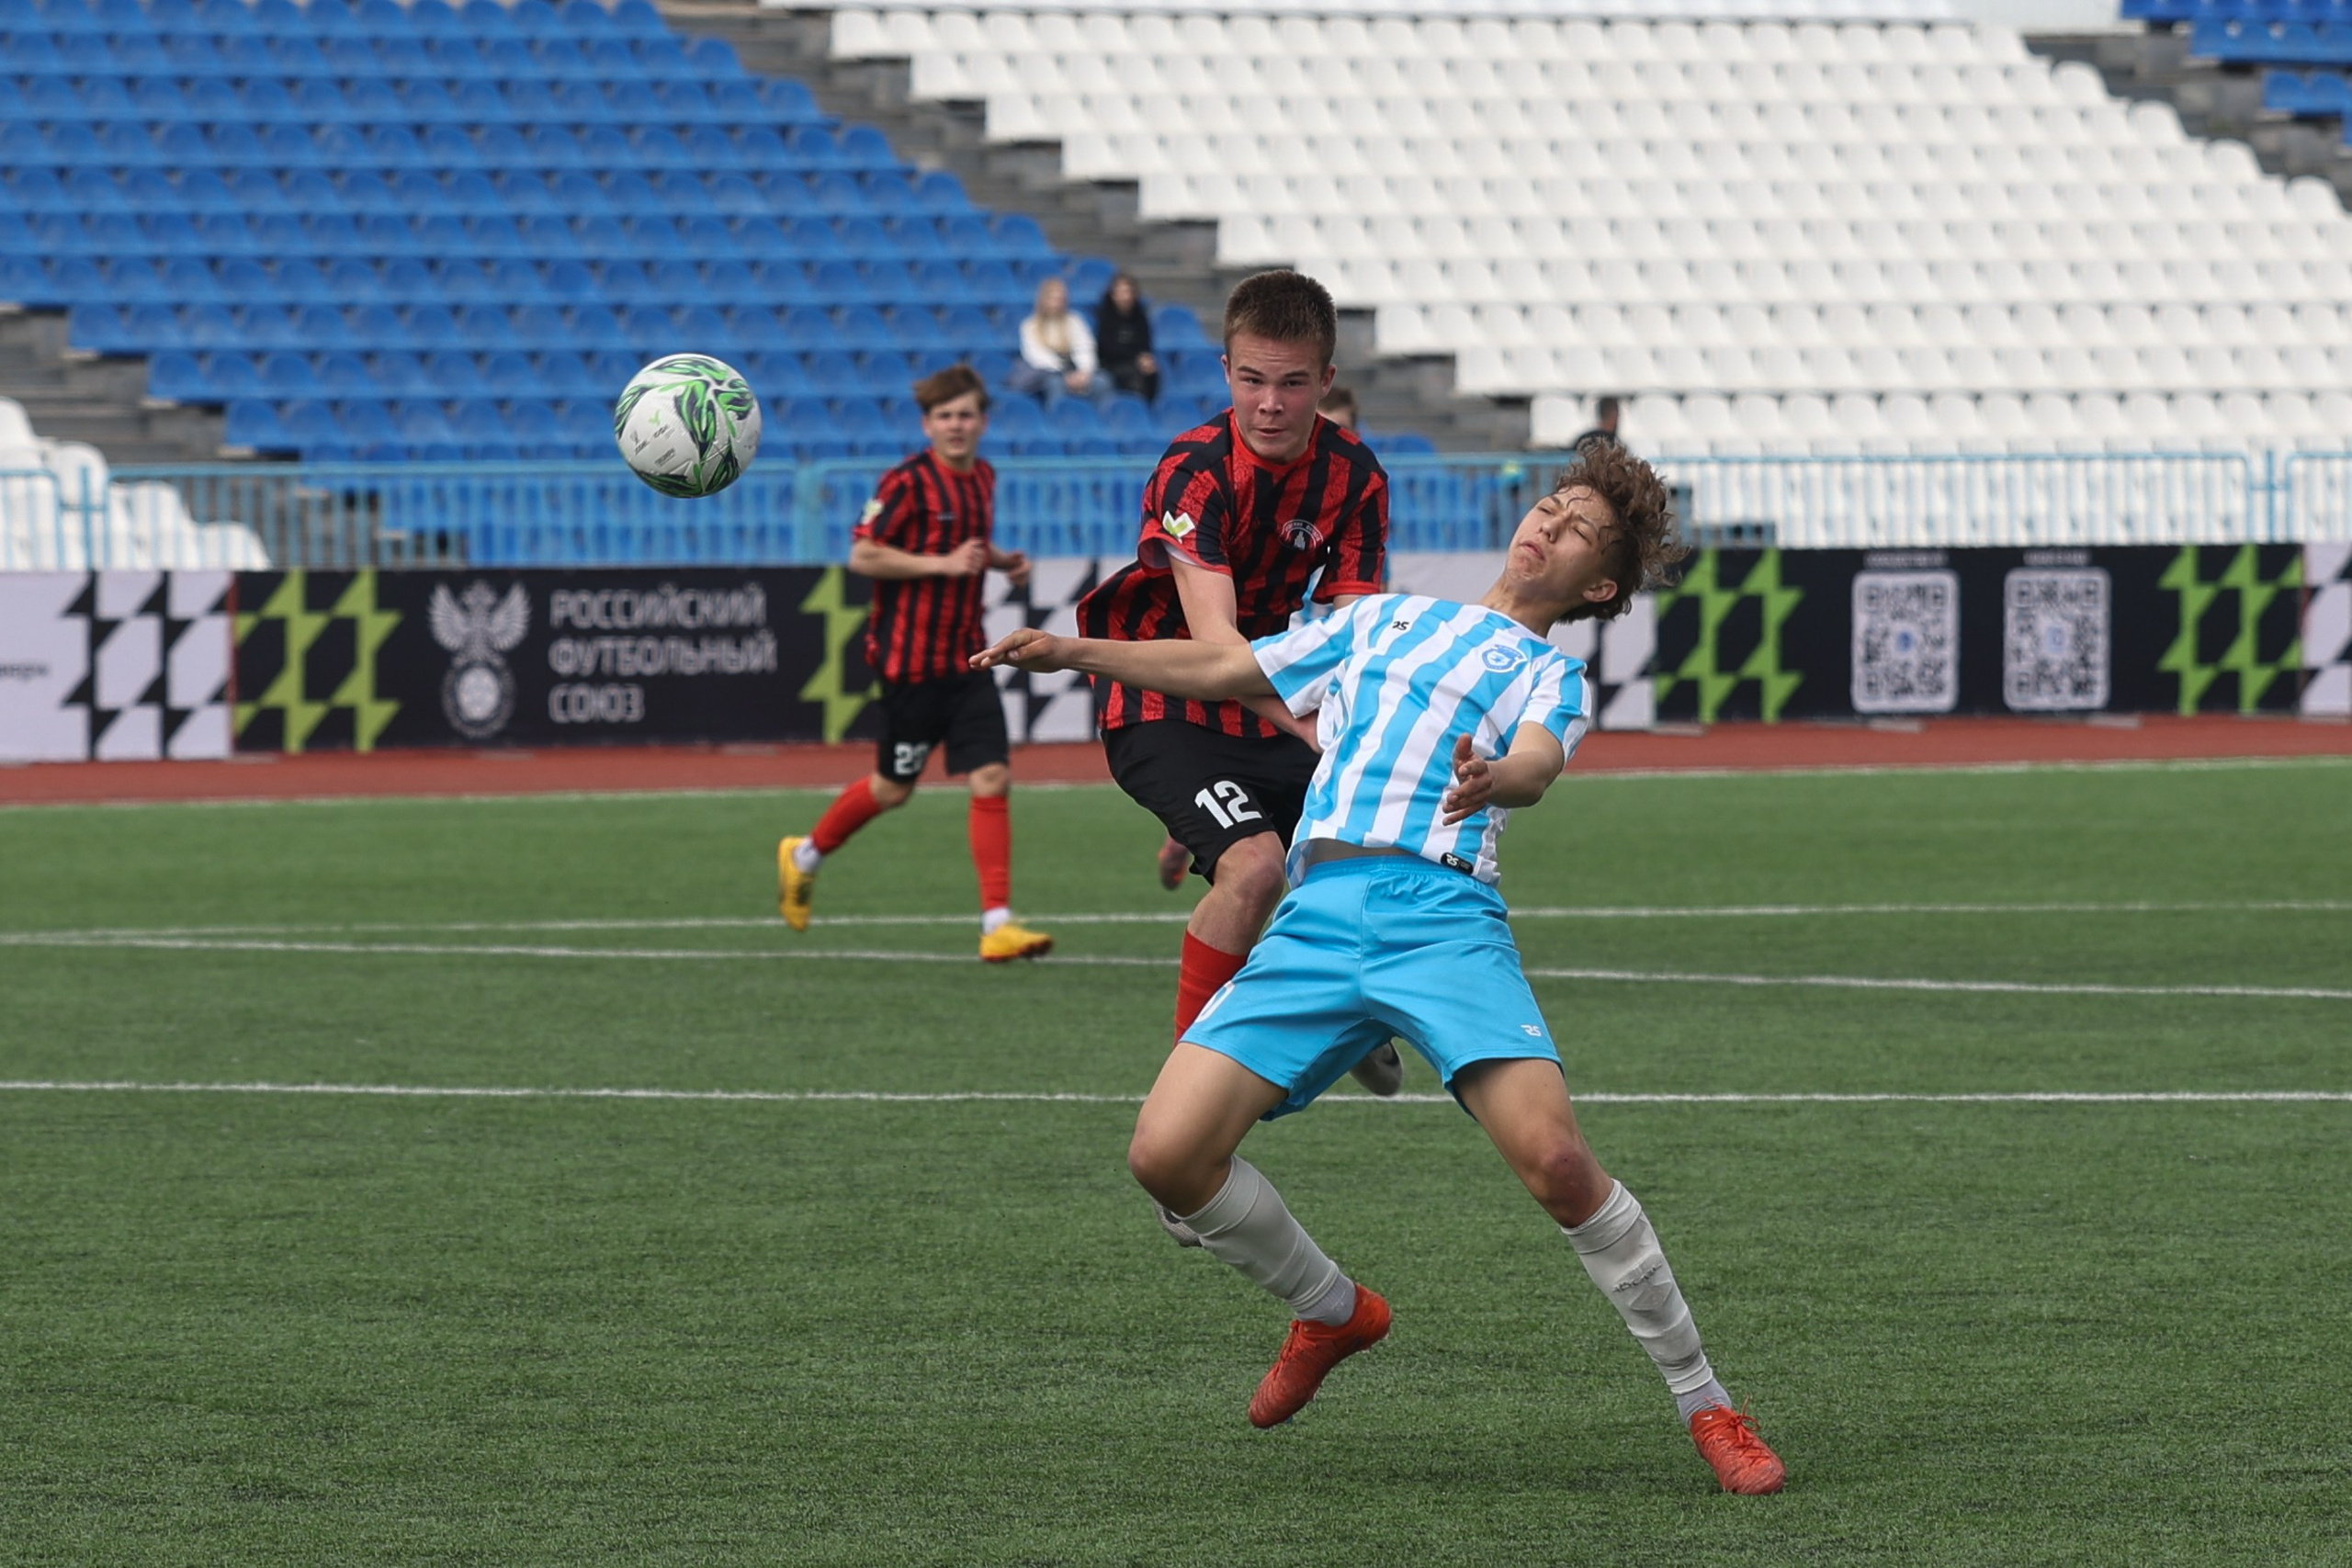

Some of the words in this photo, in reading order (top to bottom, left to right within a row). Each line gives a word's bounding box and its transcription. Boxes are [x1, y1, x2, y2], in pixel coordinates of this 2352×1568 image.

[550, 583, 766, 627] РОССИЙСКИЙ
[549, 630, 777, 675] ФУТБОЛЬНЫЙ
[549, 682, 644, 722] СОЮЗ
[1194, 780, 1262, 829] 12
